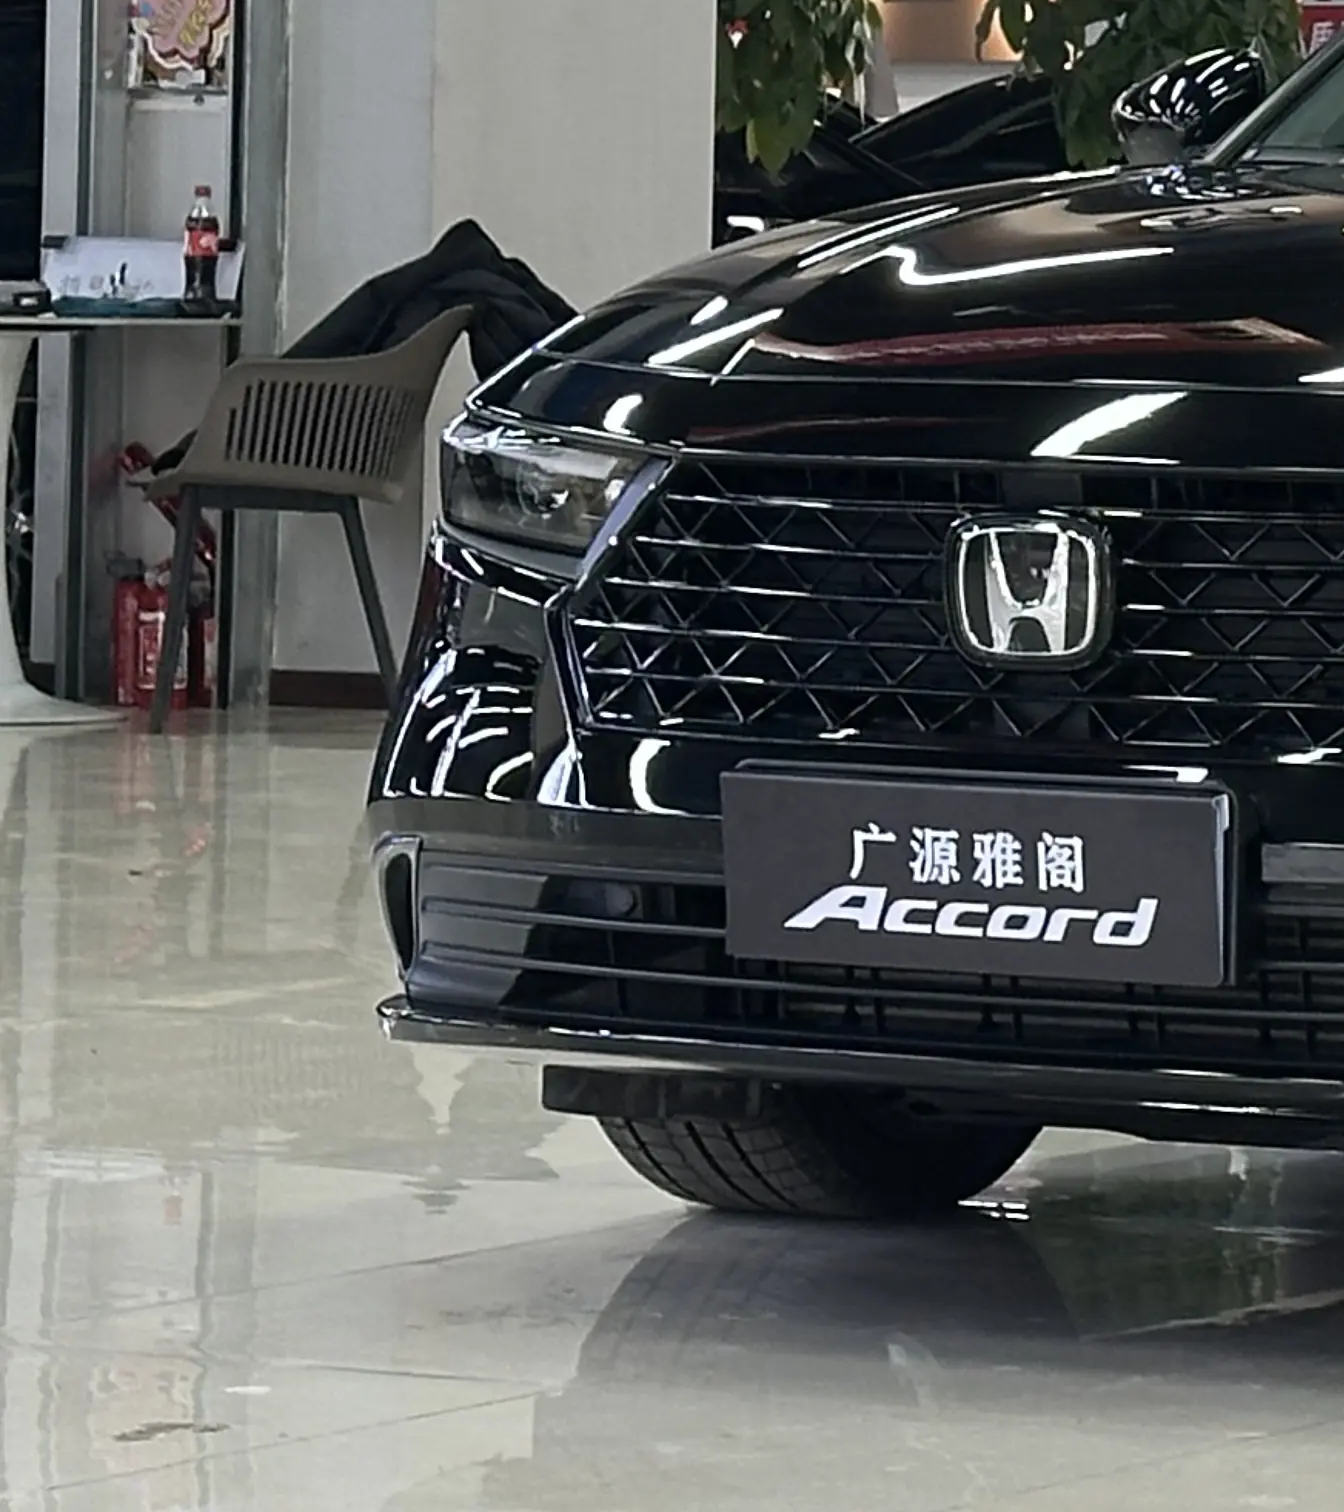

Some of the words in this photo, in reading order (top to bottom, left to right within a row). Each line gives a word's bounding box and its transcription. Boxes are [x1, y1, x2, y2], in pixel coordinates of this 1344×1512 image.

[848, 822, 1086, 893] 广源雅阁
[782, 884, 1160, 948] Accord
